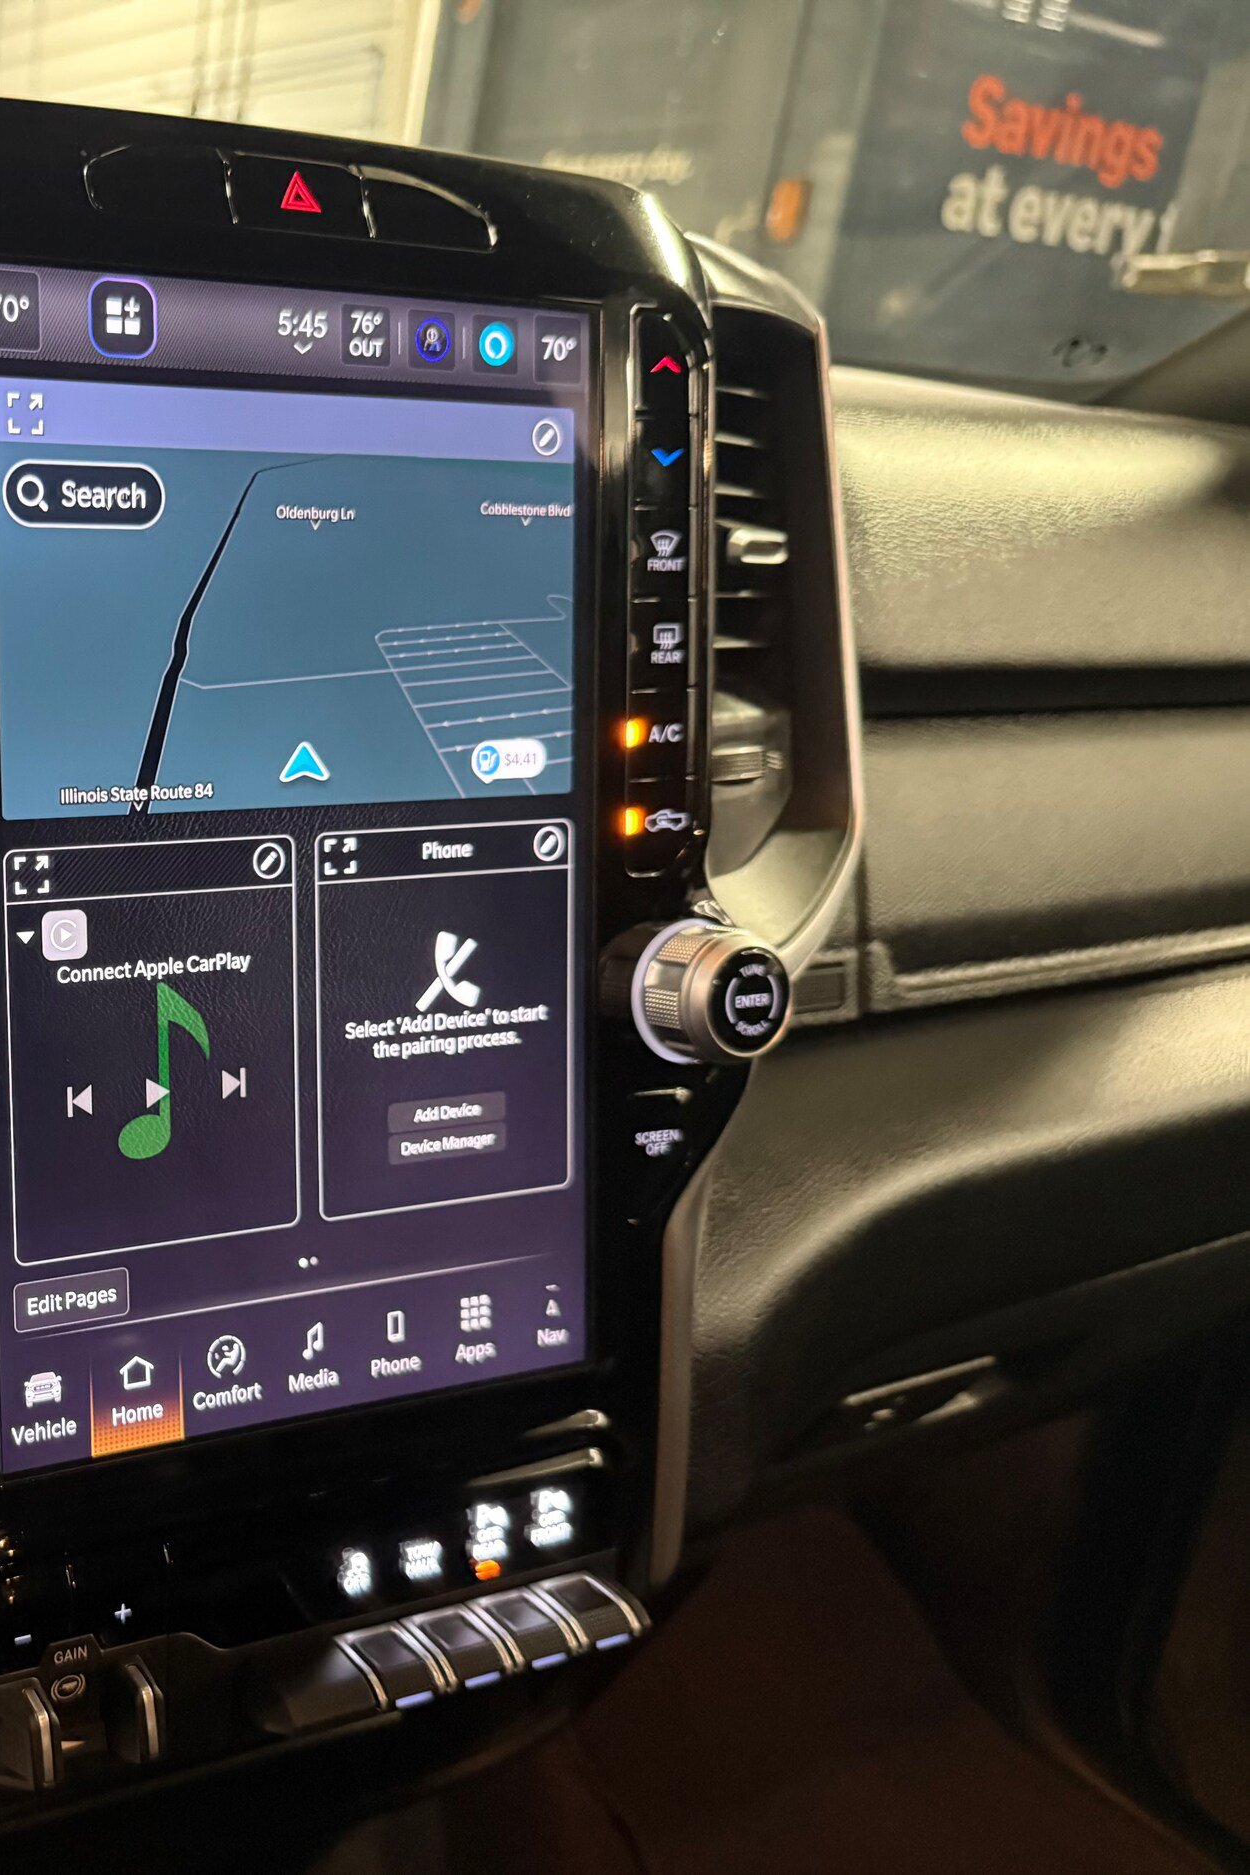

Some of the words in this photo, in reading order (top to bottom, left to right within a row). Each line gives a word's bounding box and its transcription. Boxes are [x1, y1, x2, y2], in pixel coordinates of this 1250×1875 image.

[961, 72, 1164, 189] Savings
[941, 164, 1008, 238] at
[1008, 184, 1156, 288] every
[277, 308, 328, 339] 5:45
[350, 309, 384, 335] 76°
[349, 338, 385, 358] OUT
[541, 334, 578, 362] 70°
[61, 479, 147, 510] Search
[276, 504, 338, 523] Oldenburg
[340, 507, 356, 522] Ln
[480, 502, 547, 517] Cobblestone
[547, 503, 574, 518] Blvd
[647, 556, 685, 572] FRONT
[650, 649, 684, 664] REAR
[648, 722, 684, 744] A/C
[504, 752, 538, 767] $4.41
[60, 787, 109, 805] Illinois
[109, 785, 149, 803] State
[150, 783, 193, 801] Route
[194, 782, 214, 799] 84
[422, 841, 475, 861] Phone
[56, 962, 132, 984] Connect
[134, 957, 184, 980] Apple
[186, 952, 252, 974] CarPlay
[735, 992, 771, 1009] ENTER
[344, 1019, 396, 1040] Select
[492, 1007, 510, 1025] to
[510, 1004, 549, 1023] start
[372, 1040, 401, 1059] the
[401, 1034, 456, 1060] pairing
[457, 1030, 523, 1054] process.
[413, 1106, 440, 1123] Add
[440, 1102, 483, 1121] Device
[400, 1138, 443, 1157] Device
[442, 1133, 497, 1150] Manager
[634, 1128, 682, 1146] SCREEN
[645, 1141, 670, 1157] OFF
[26, 1293, 63, 1317] Edit
[65, 1287, 118, 1311] Pages
[536, 1327, 570, 1348] Nav
[455, 1342, 498, 1366] Apps
[370, 1355, 422, 1379] Phone
[288, 1367, 341, 1394] Media
[192, 1382, 263, 1411] Comfort
[111, 1402, 164, 1427] Home
[11, 1417, 78, 1446] Vehicle
[54, 1645, 88, 1664] GAIN
